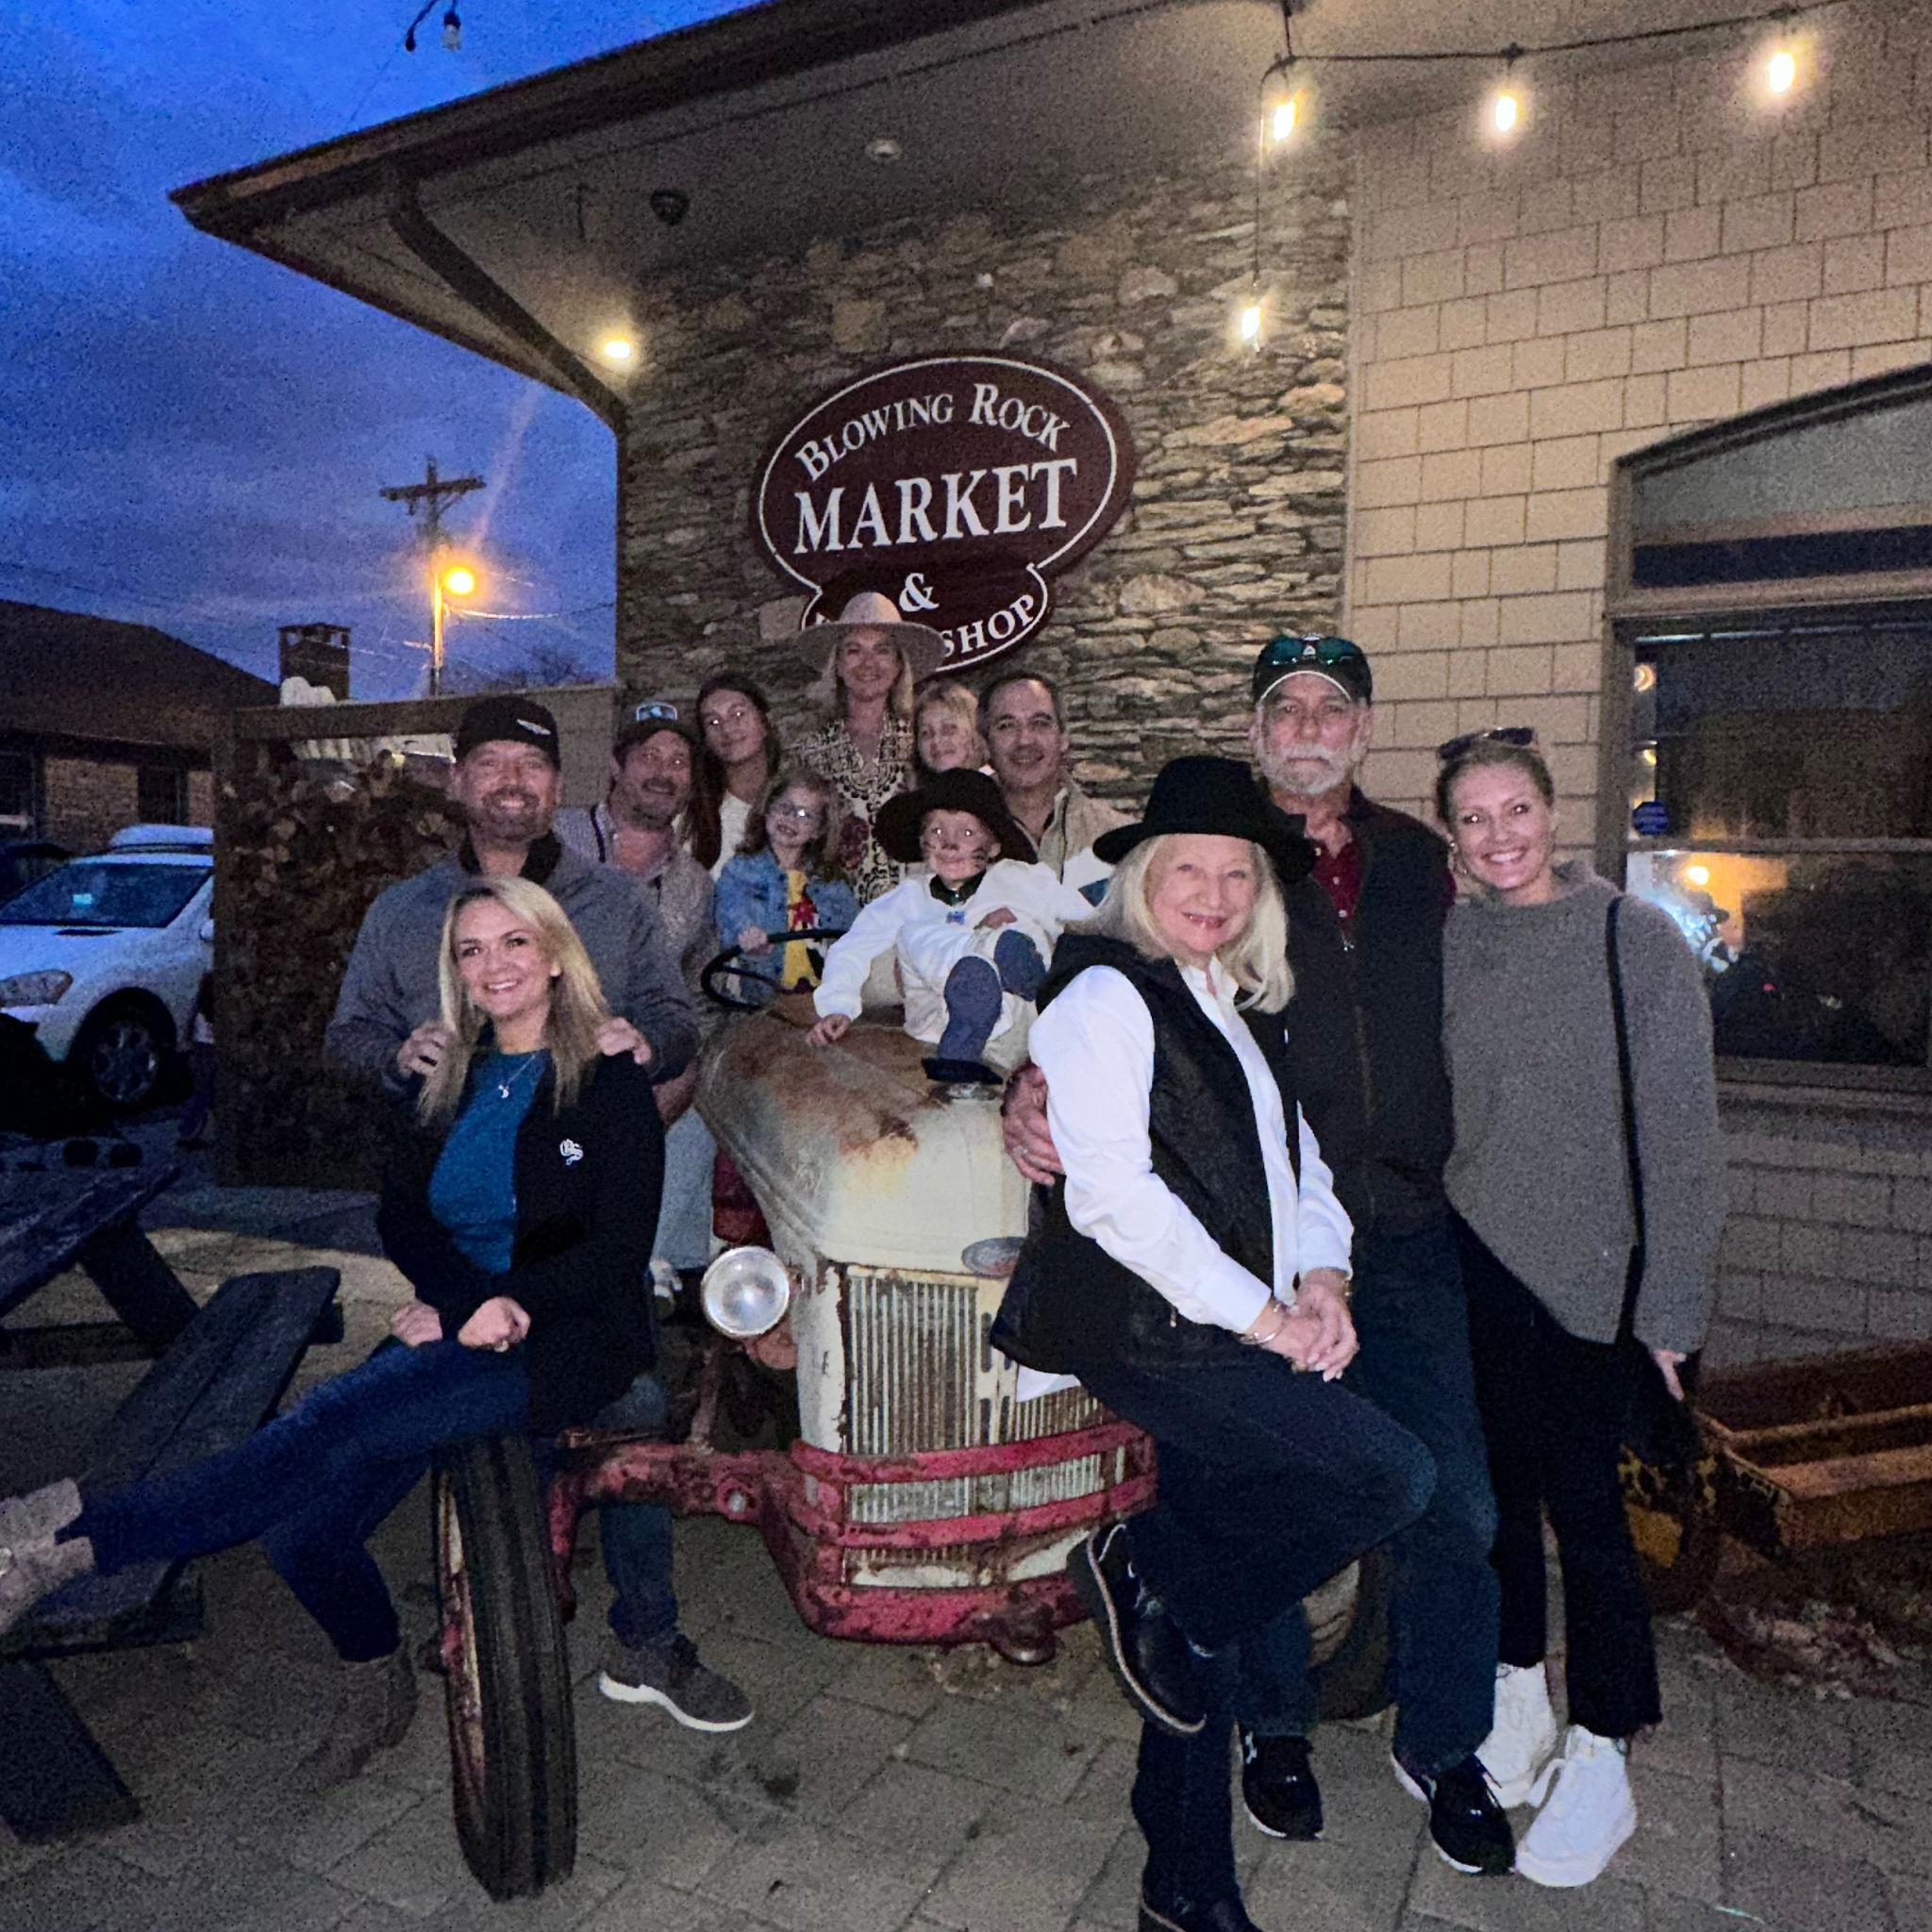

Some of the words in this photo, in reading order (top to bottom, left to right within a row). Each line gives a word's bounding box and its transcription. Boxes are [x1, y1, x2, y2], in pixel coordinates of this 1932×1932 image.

[795, 393, 953, 482] BLOWING
[969, 383, 1071, 452] ROCK
[793, 458, 1077, 554] MARKET
[899, 573, 940, 612] &
[941, 594, 1034, 658] SHOP
